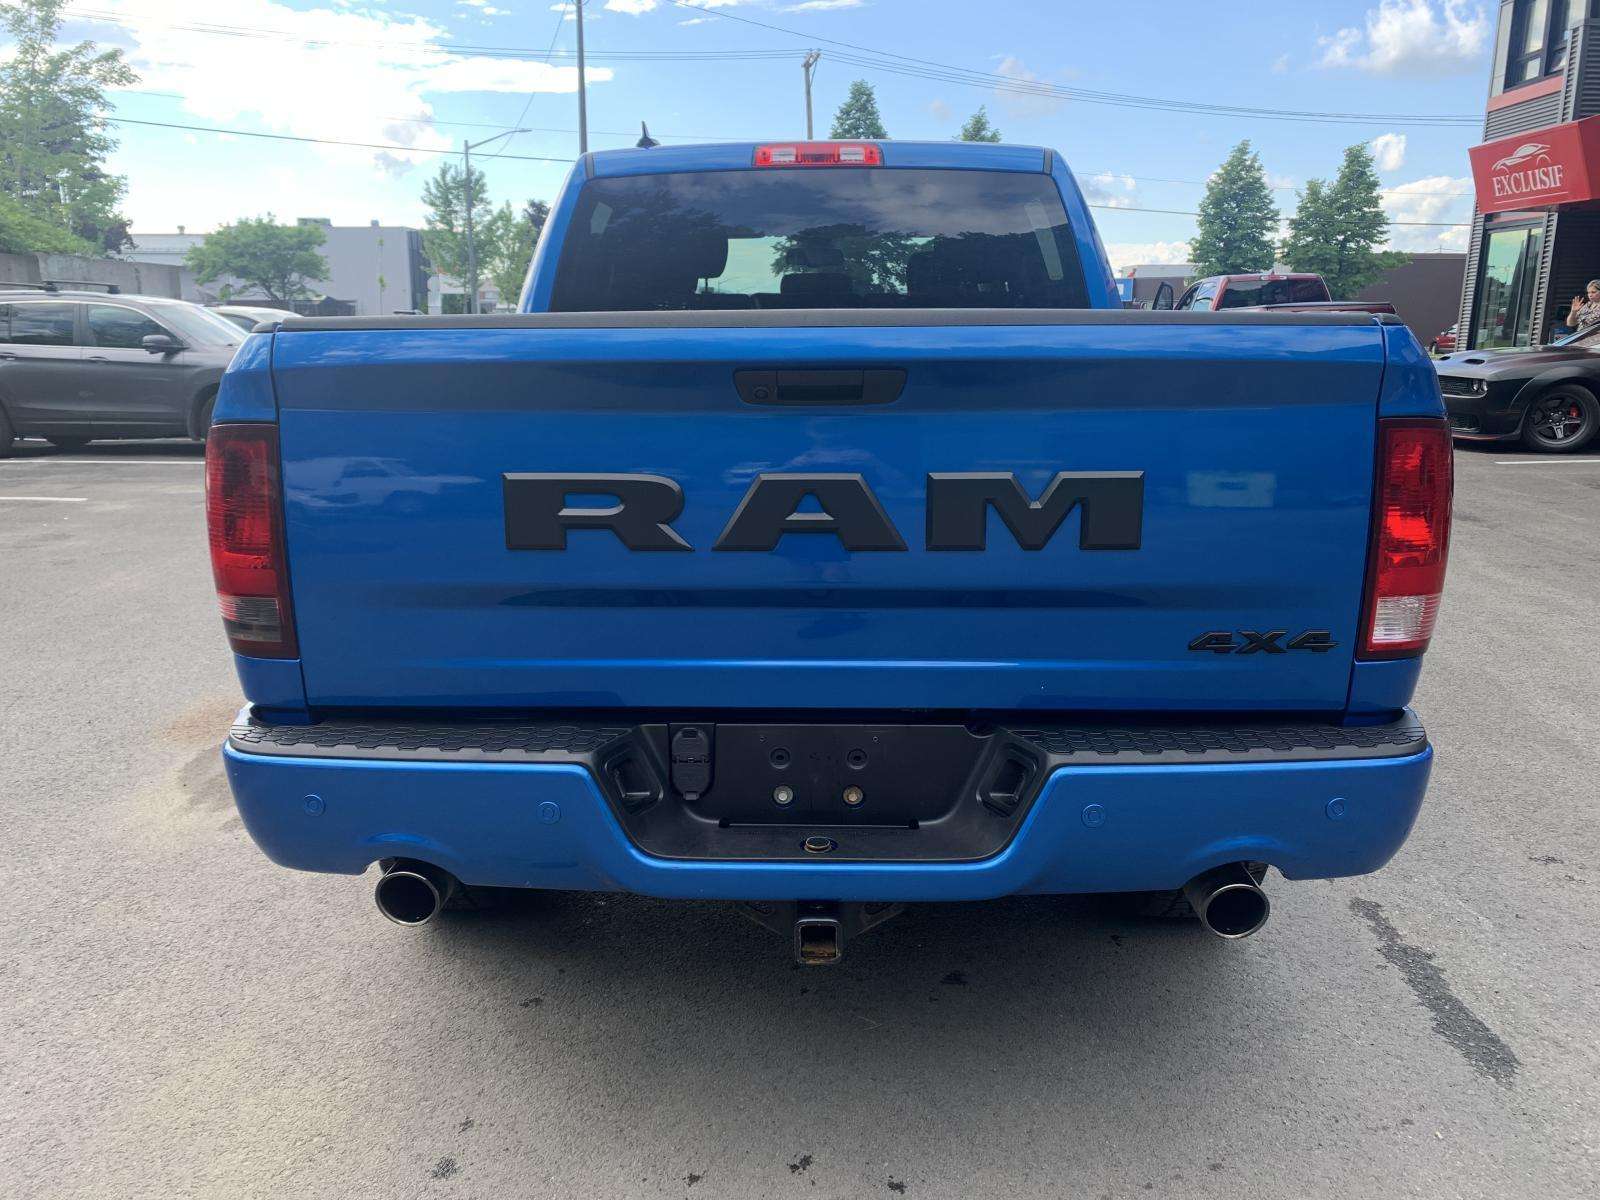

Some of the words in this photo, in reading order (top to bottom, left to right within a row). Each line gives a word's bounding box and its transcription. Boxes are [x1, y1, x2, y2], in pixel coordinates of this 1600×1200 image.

[1492, 165, 1564, 197] EXCLUSIF
[502, 471, 1145, 551] RAM
[1188, 629, 1338, 654] 4X4
